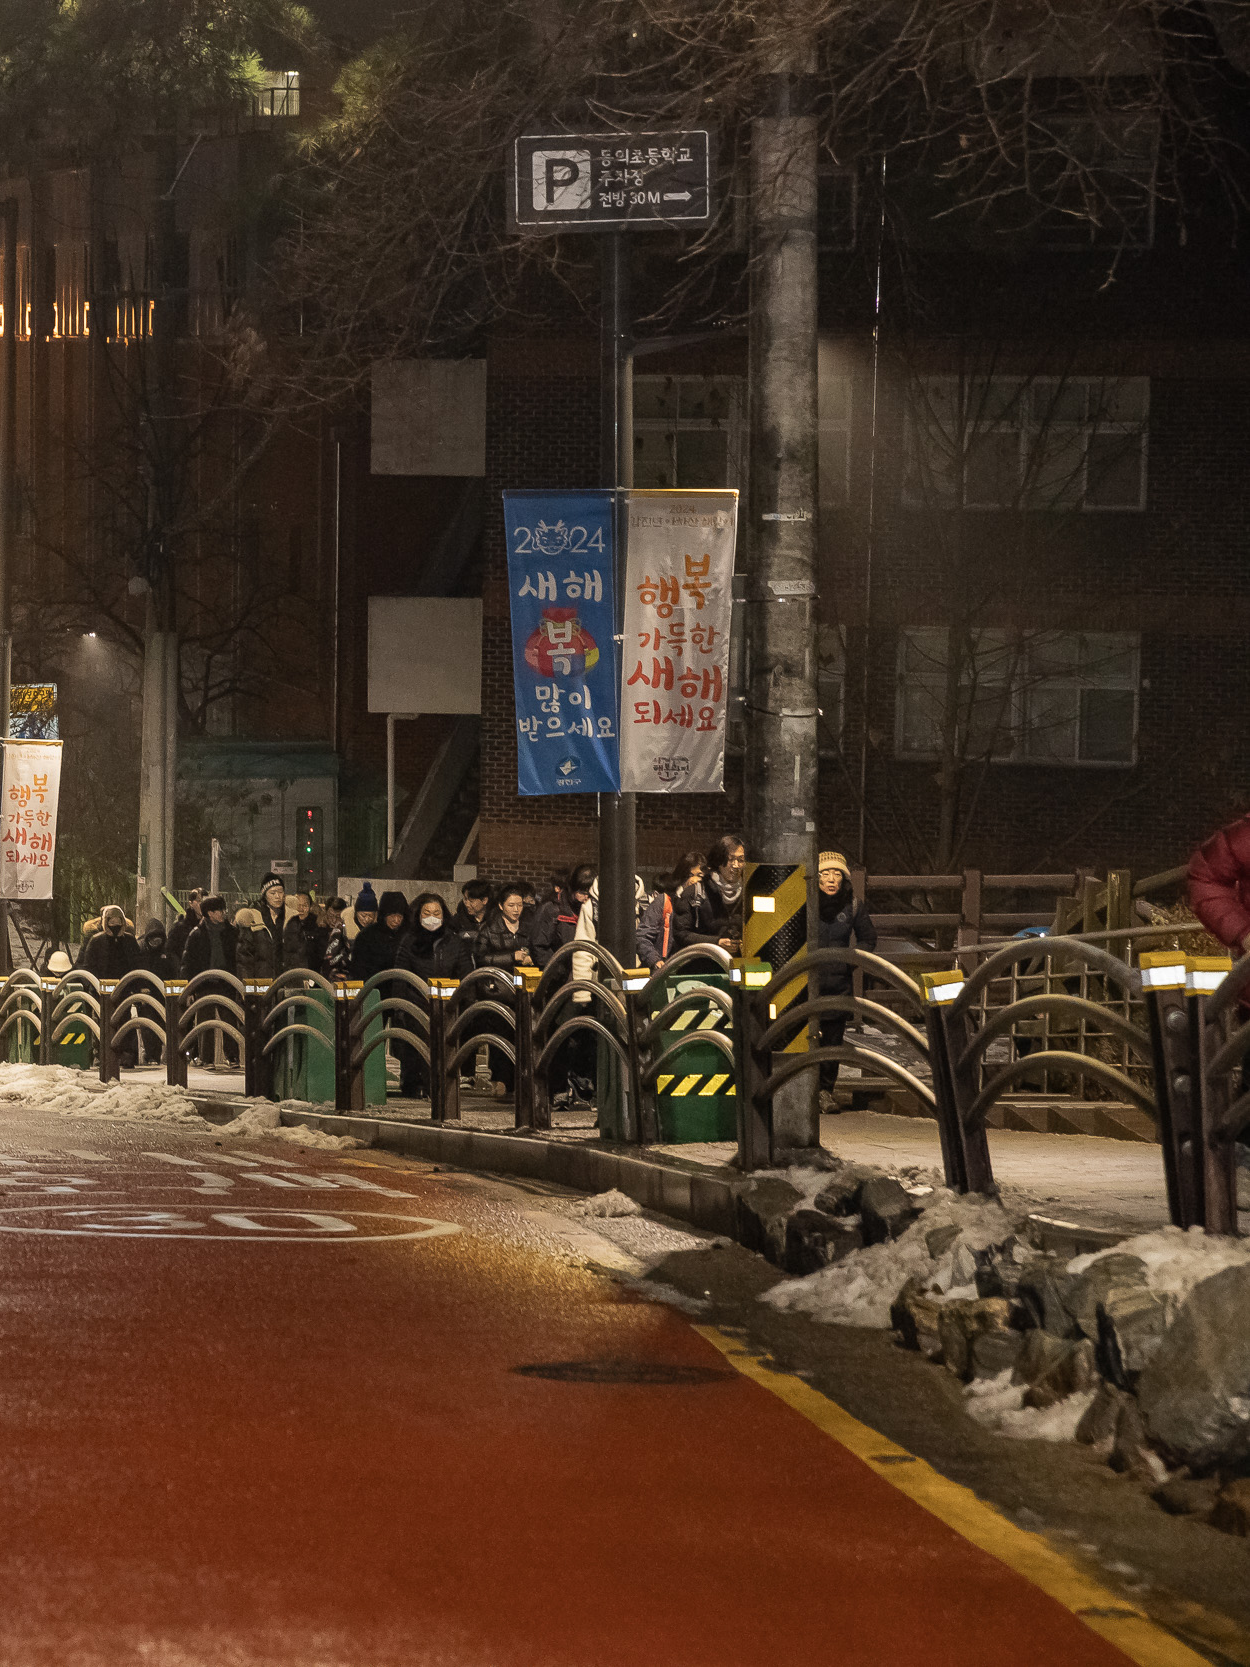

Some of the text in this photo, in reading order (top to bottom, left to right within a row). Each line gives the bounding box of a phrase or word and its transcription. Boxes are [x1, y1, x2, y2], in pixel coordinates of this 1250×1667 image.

[546, 158, 579, 204] P
[598, 168, 644, 186] 주차장
[599, 192, 626, 207] 전방
[518, 569, 603, 602] 새해
[636, 553, 712, 619] 행복
[546, 620, 576, 676] 복
[638, 622, 721, 656] 가득한
[627, 656, 723, 703] 새해
[535, 683, 591, 714] 많이
[518, 716, 615, 742] 받으세요
[634, 700, 718, 732] 되세요
[8, 773, 49, 808] 행복
[7, 809, 52, 827] 가득한
[2, 827, 53, 853] 새해
[5, 850, 50, 868] 되세요
[58, 1210, 358, 1233] 30
